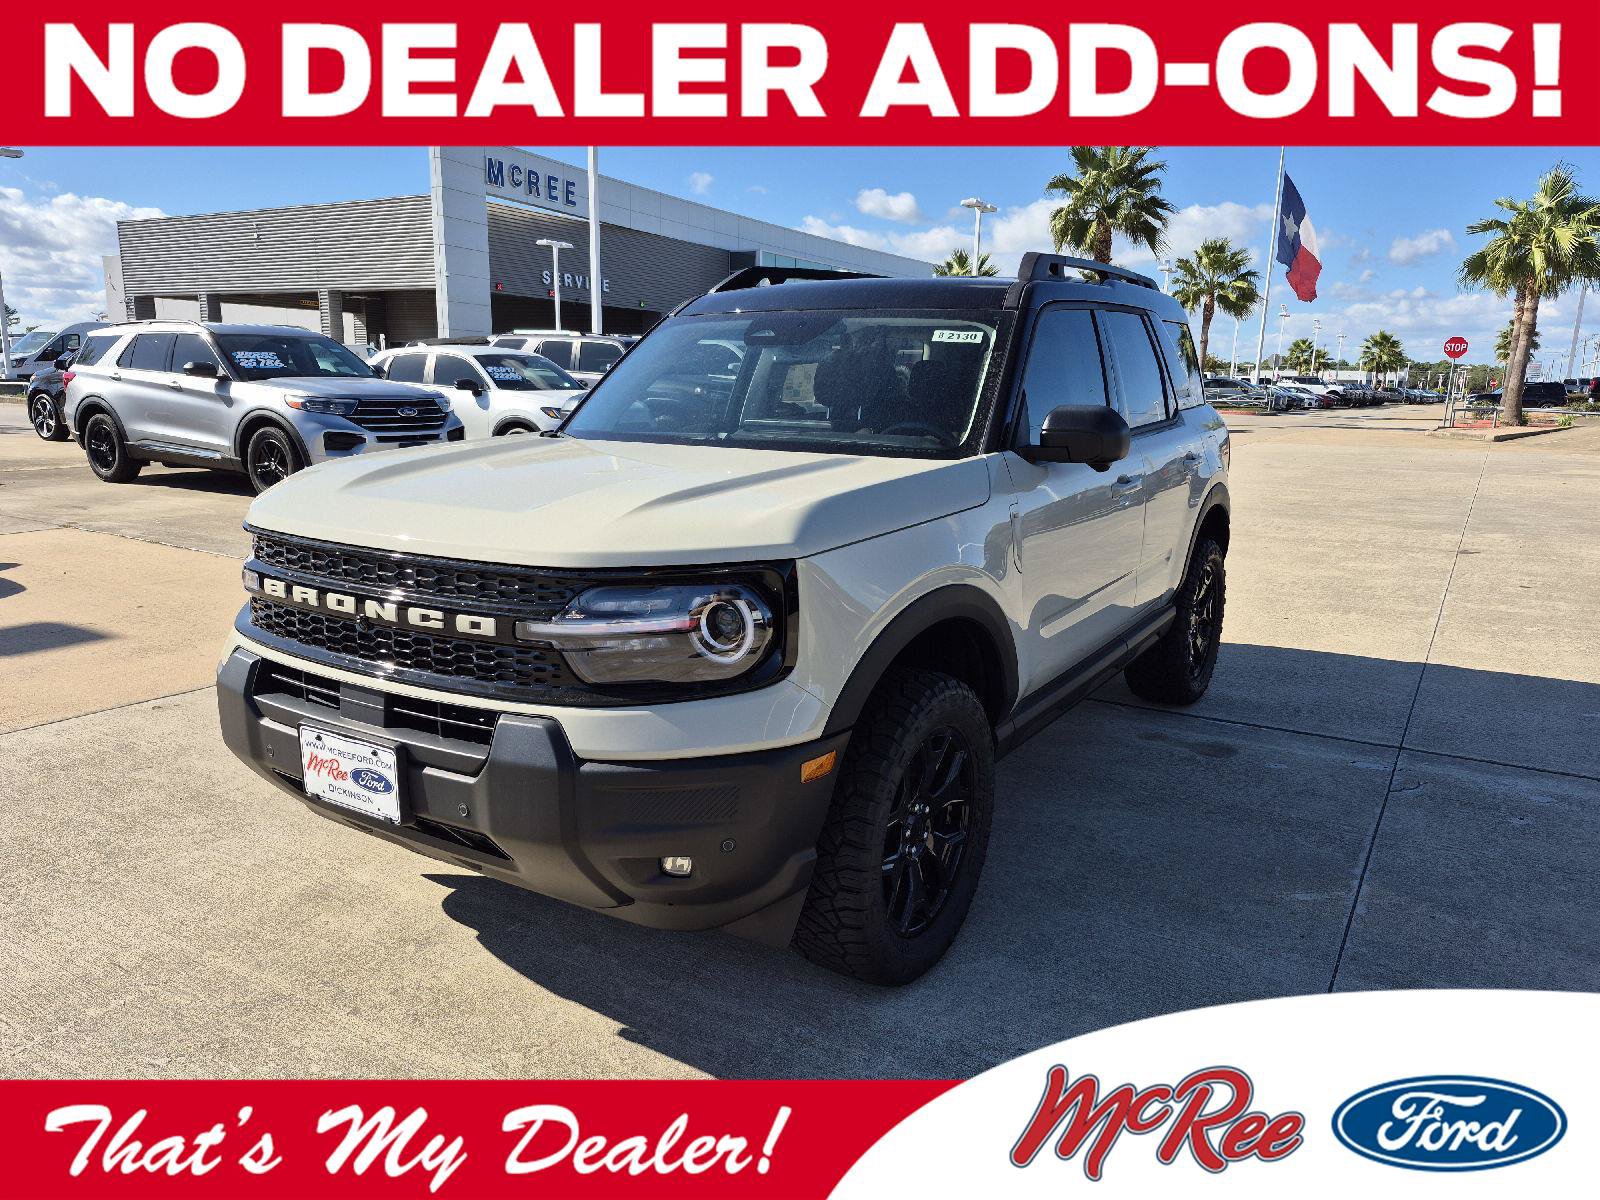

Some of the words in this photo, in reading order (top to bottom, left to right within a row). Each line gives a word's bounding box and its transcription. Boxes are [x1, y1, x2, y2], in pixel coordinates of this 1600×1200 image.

[1445, 343, 1467, 352] STOP
[263, 578, 497, 637] BRONCO
[306, 751, 349, 781] McRee
[359, 771, 385, 792] Ford
[328, 783, 374, 804] DICKINSON
